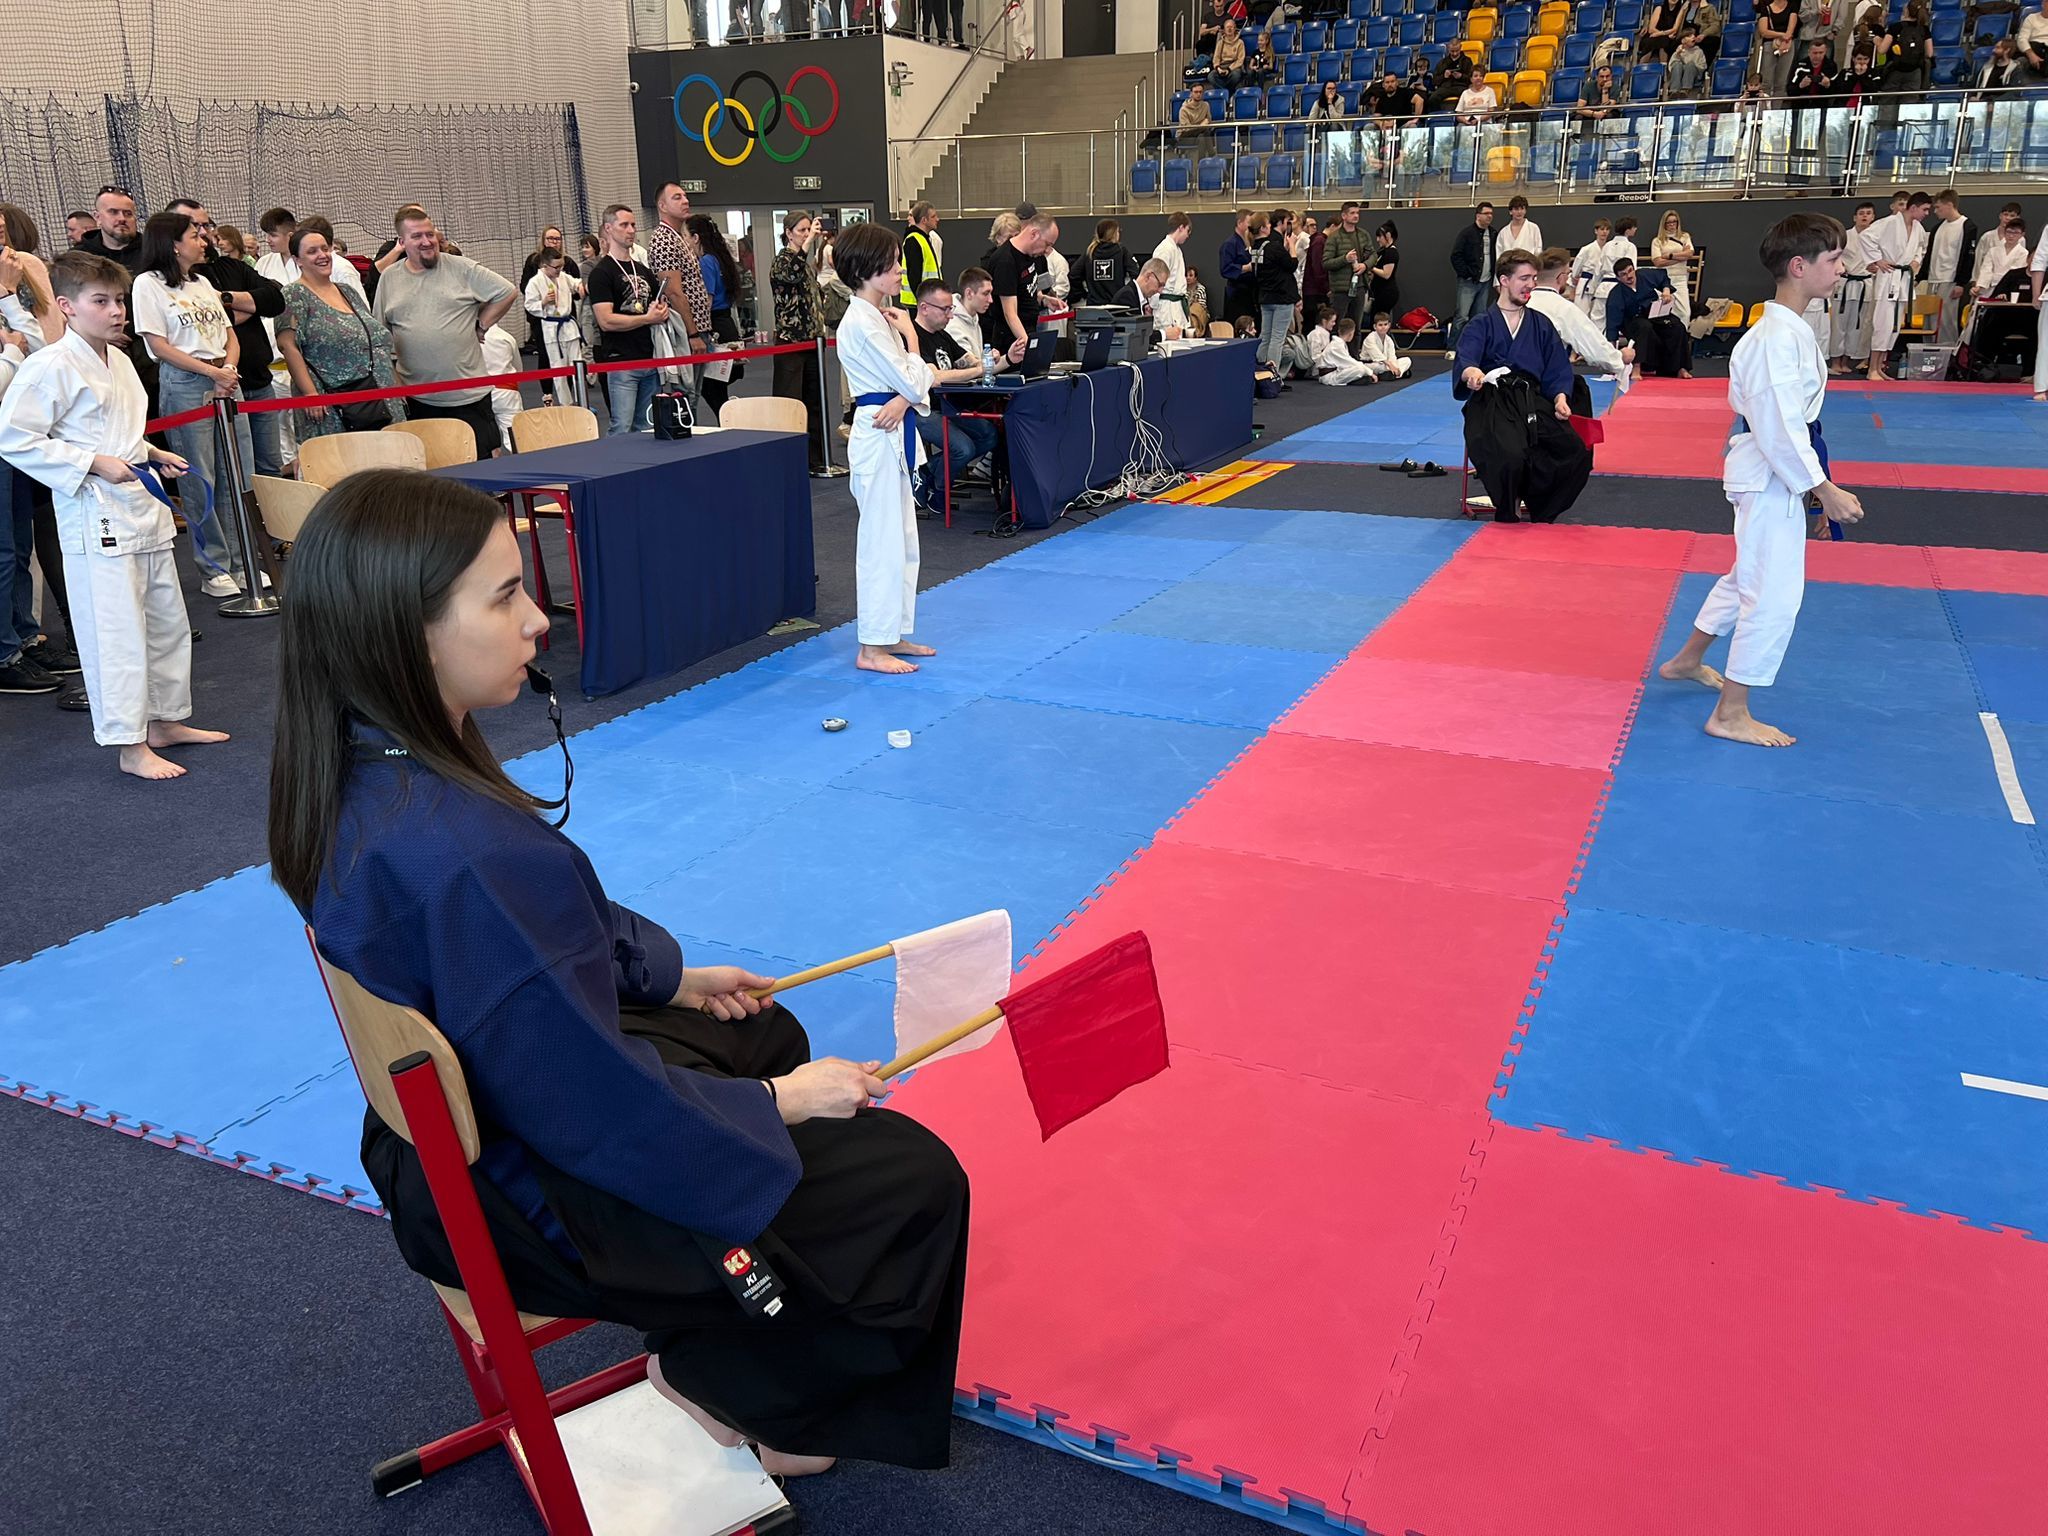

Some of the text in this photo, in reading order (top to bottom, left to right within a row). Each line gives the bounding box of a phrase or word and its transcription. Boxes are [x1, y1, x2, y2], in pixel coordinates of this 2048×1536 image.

[1619, 194, 1649, 202] Reebok
[723, 1248, 751, 1275] KI
[742, 1274, 771, 1299] INTERNATIONAL
[745, 1271, 758, 1287] KI
